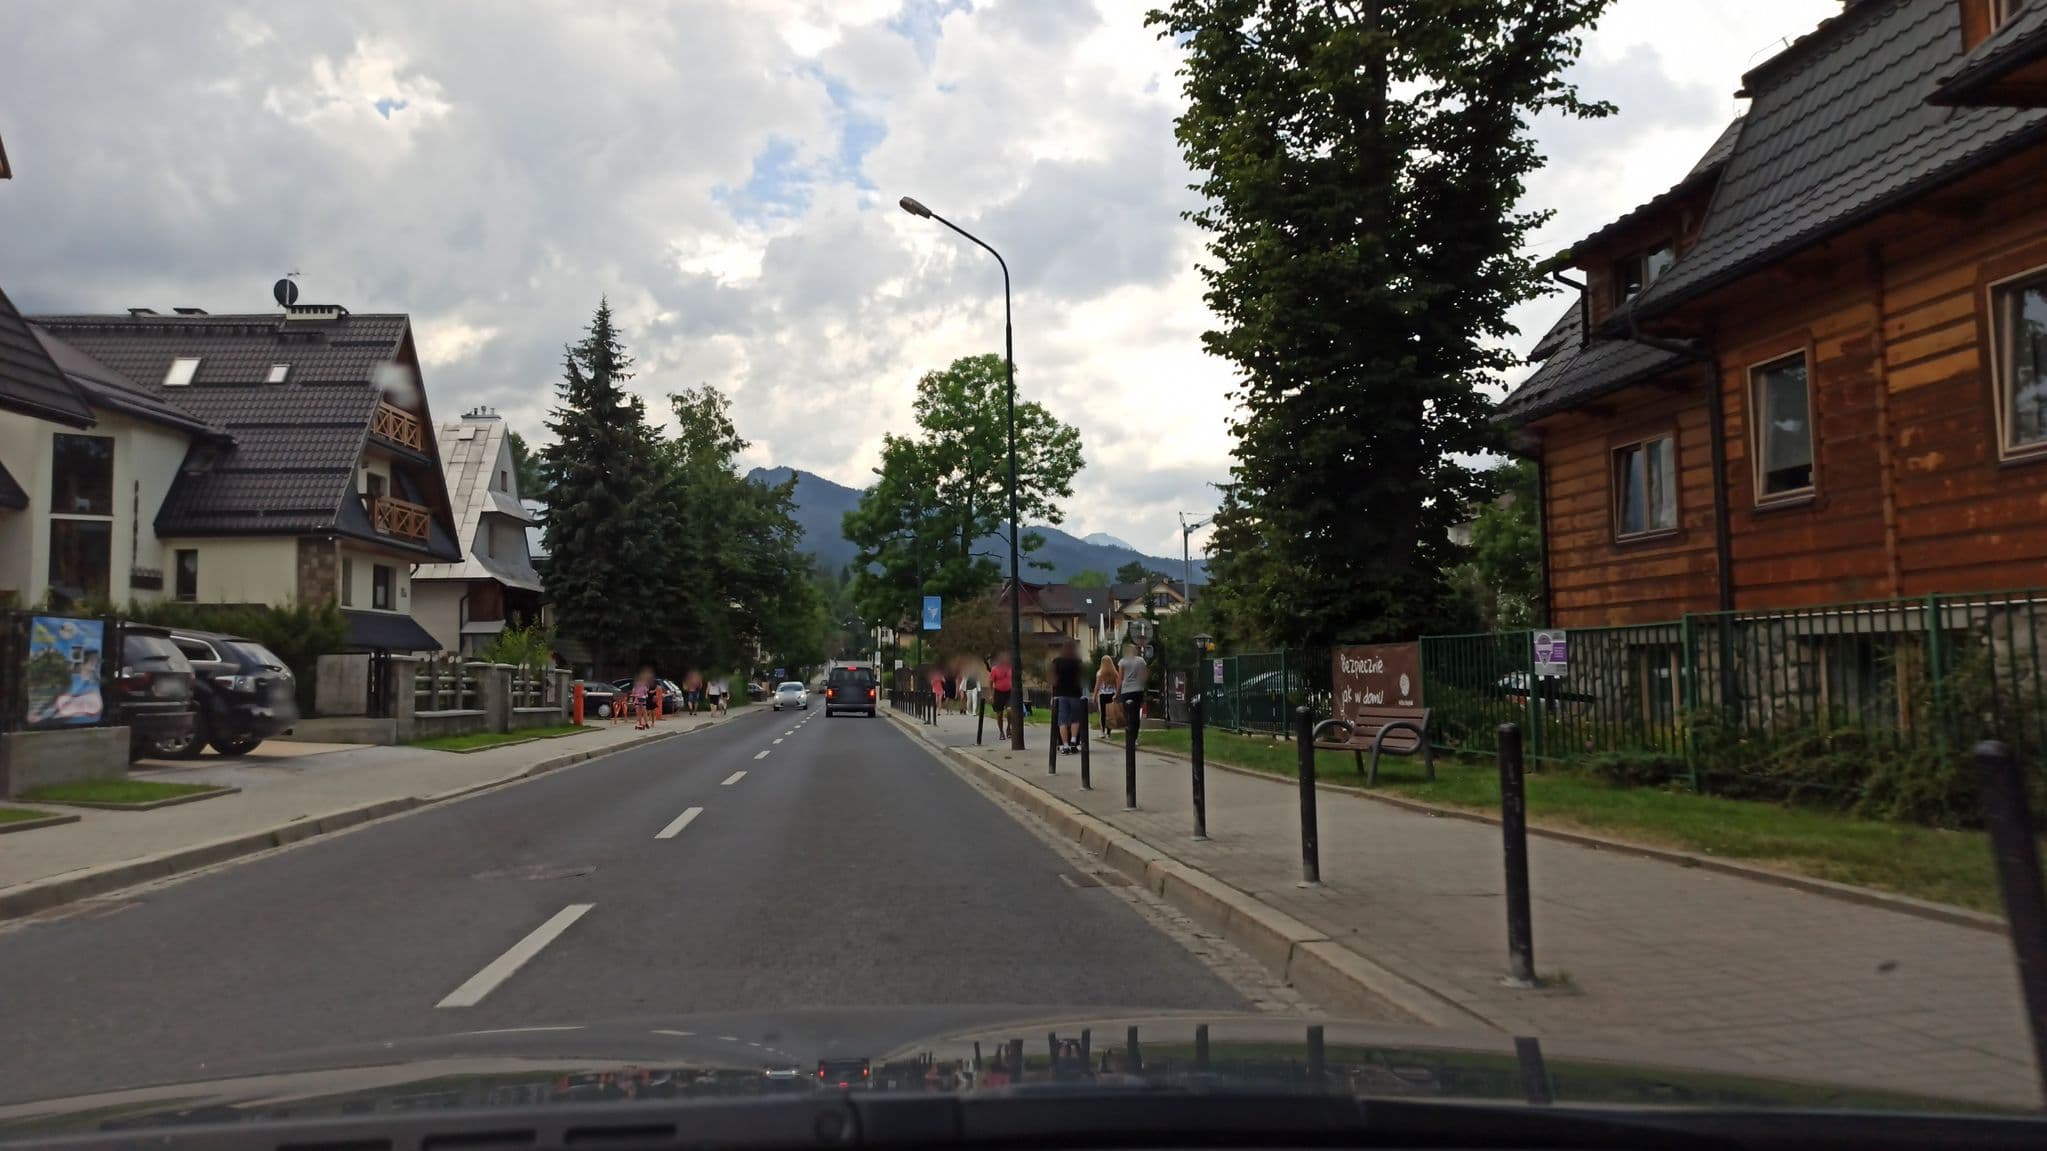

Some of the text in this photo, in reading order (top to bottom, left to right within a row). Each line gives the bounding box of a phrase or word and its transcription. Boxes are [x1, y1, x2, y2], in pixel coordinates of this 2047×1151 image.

[1340, 653, 1384, 679] Bezpiecznie
[1354, 690, 1362, 703] w
[1363, 686, 1384, 705] domu
